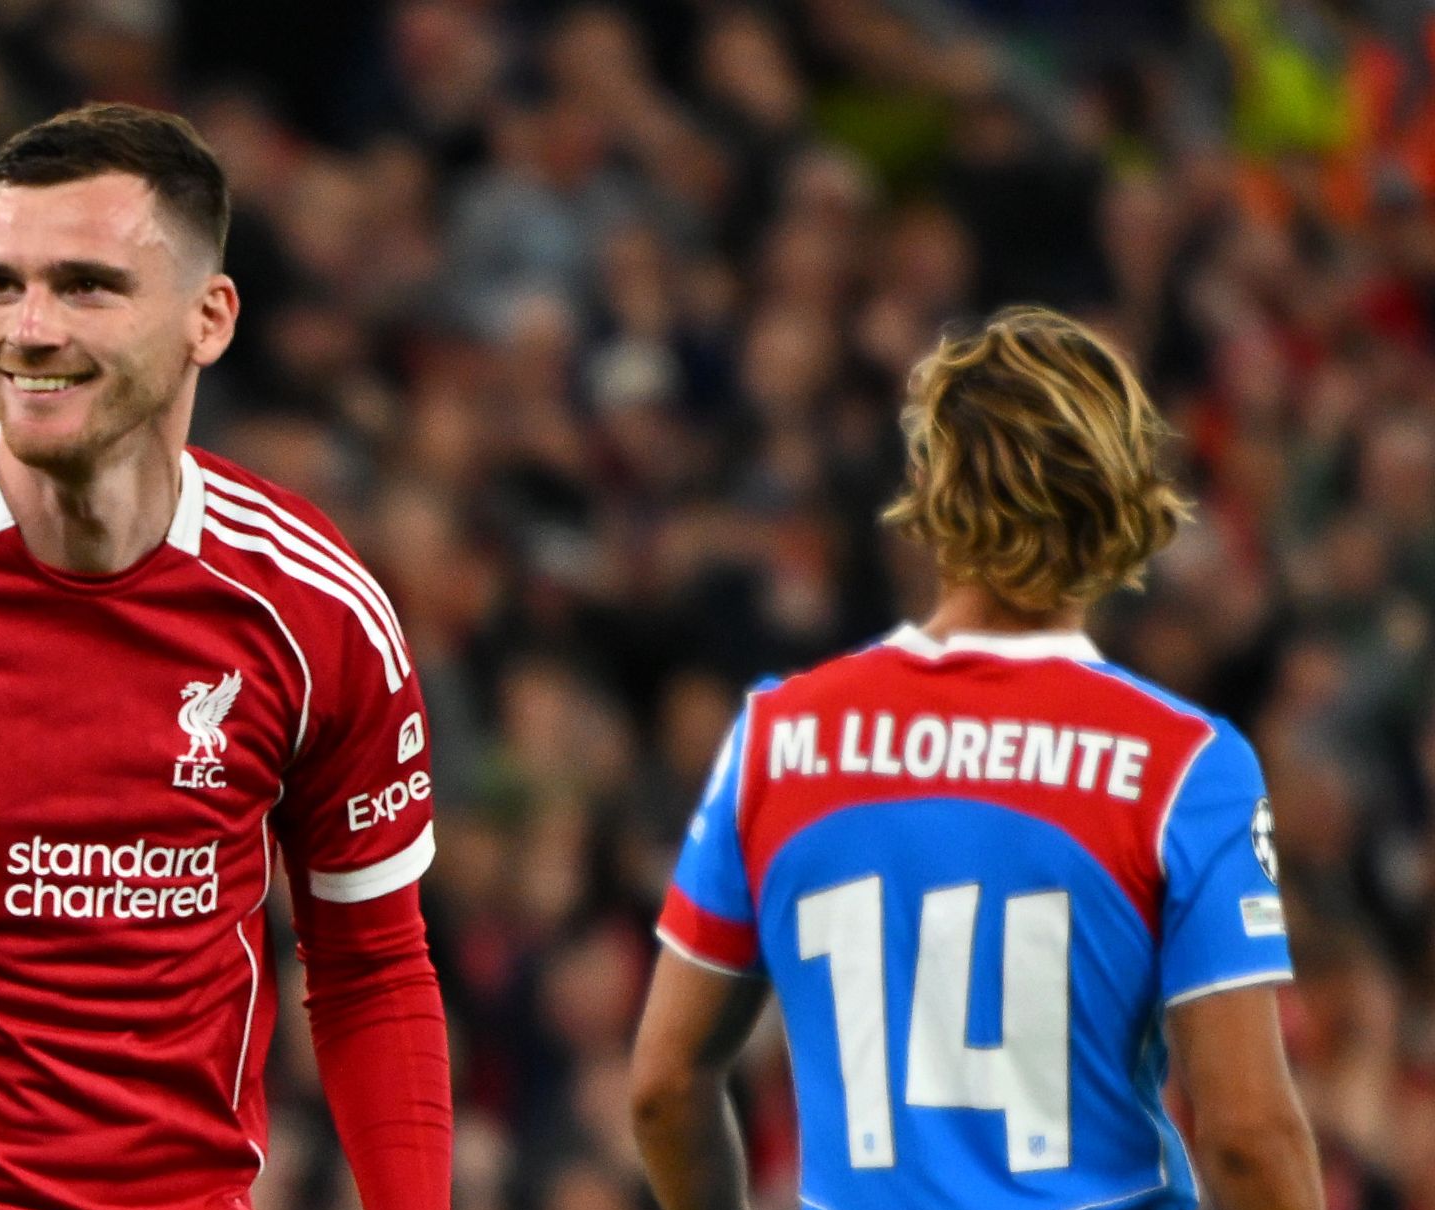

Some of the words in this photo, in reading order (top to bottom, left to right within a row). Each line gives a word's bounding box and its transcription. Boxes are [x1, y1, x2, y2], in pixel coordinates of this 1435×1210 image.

[770, 717, 827, 779] M.
[840, 715, 1149, 801] LLORENTE
[347, 770, 432, 832] Expe
[7, 835, 219, 878] standard
[4, 872, 219, 919] chartered
[797, 875, 1070, 1173] 14
